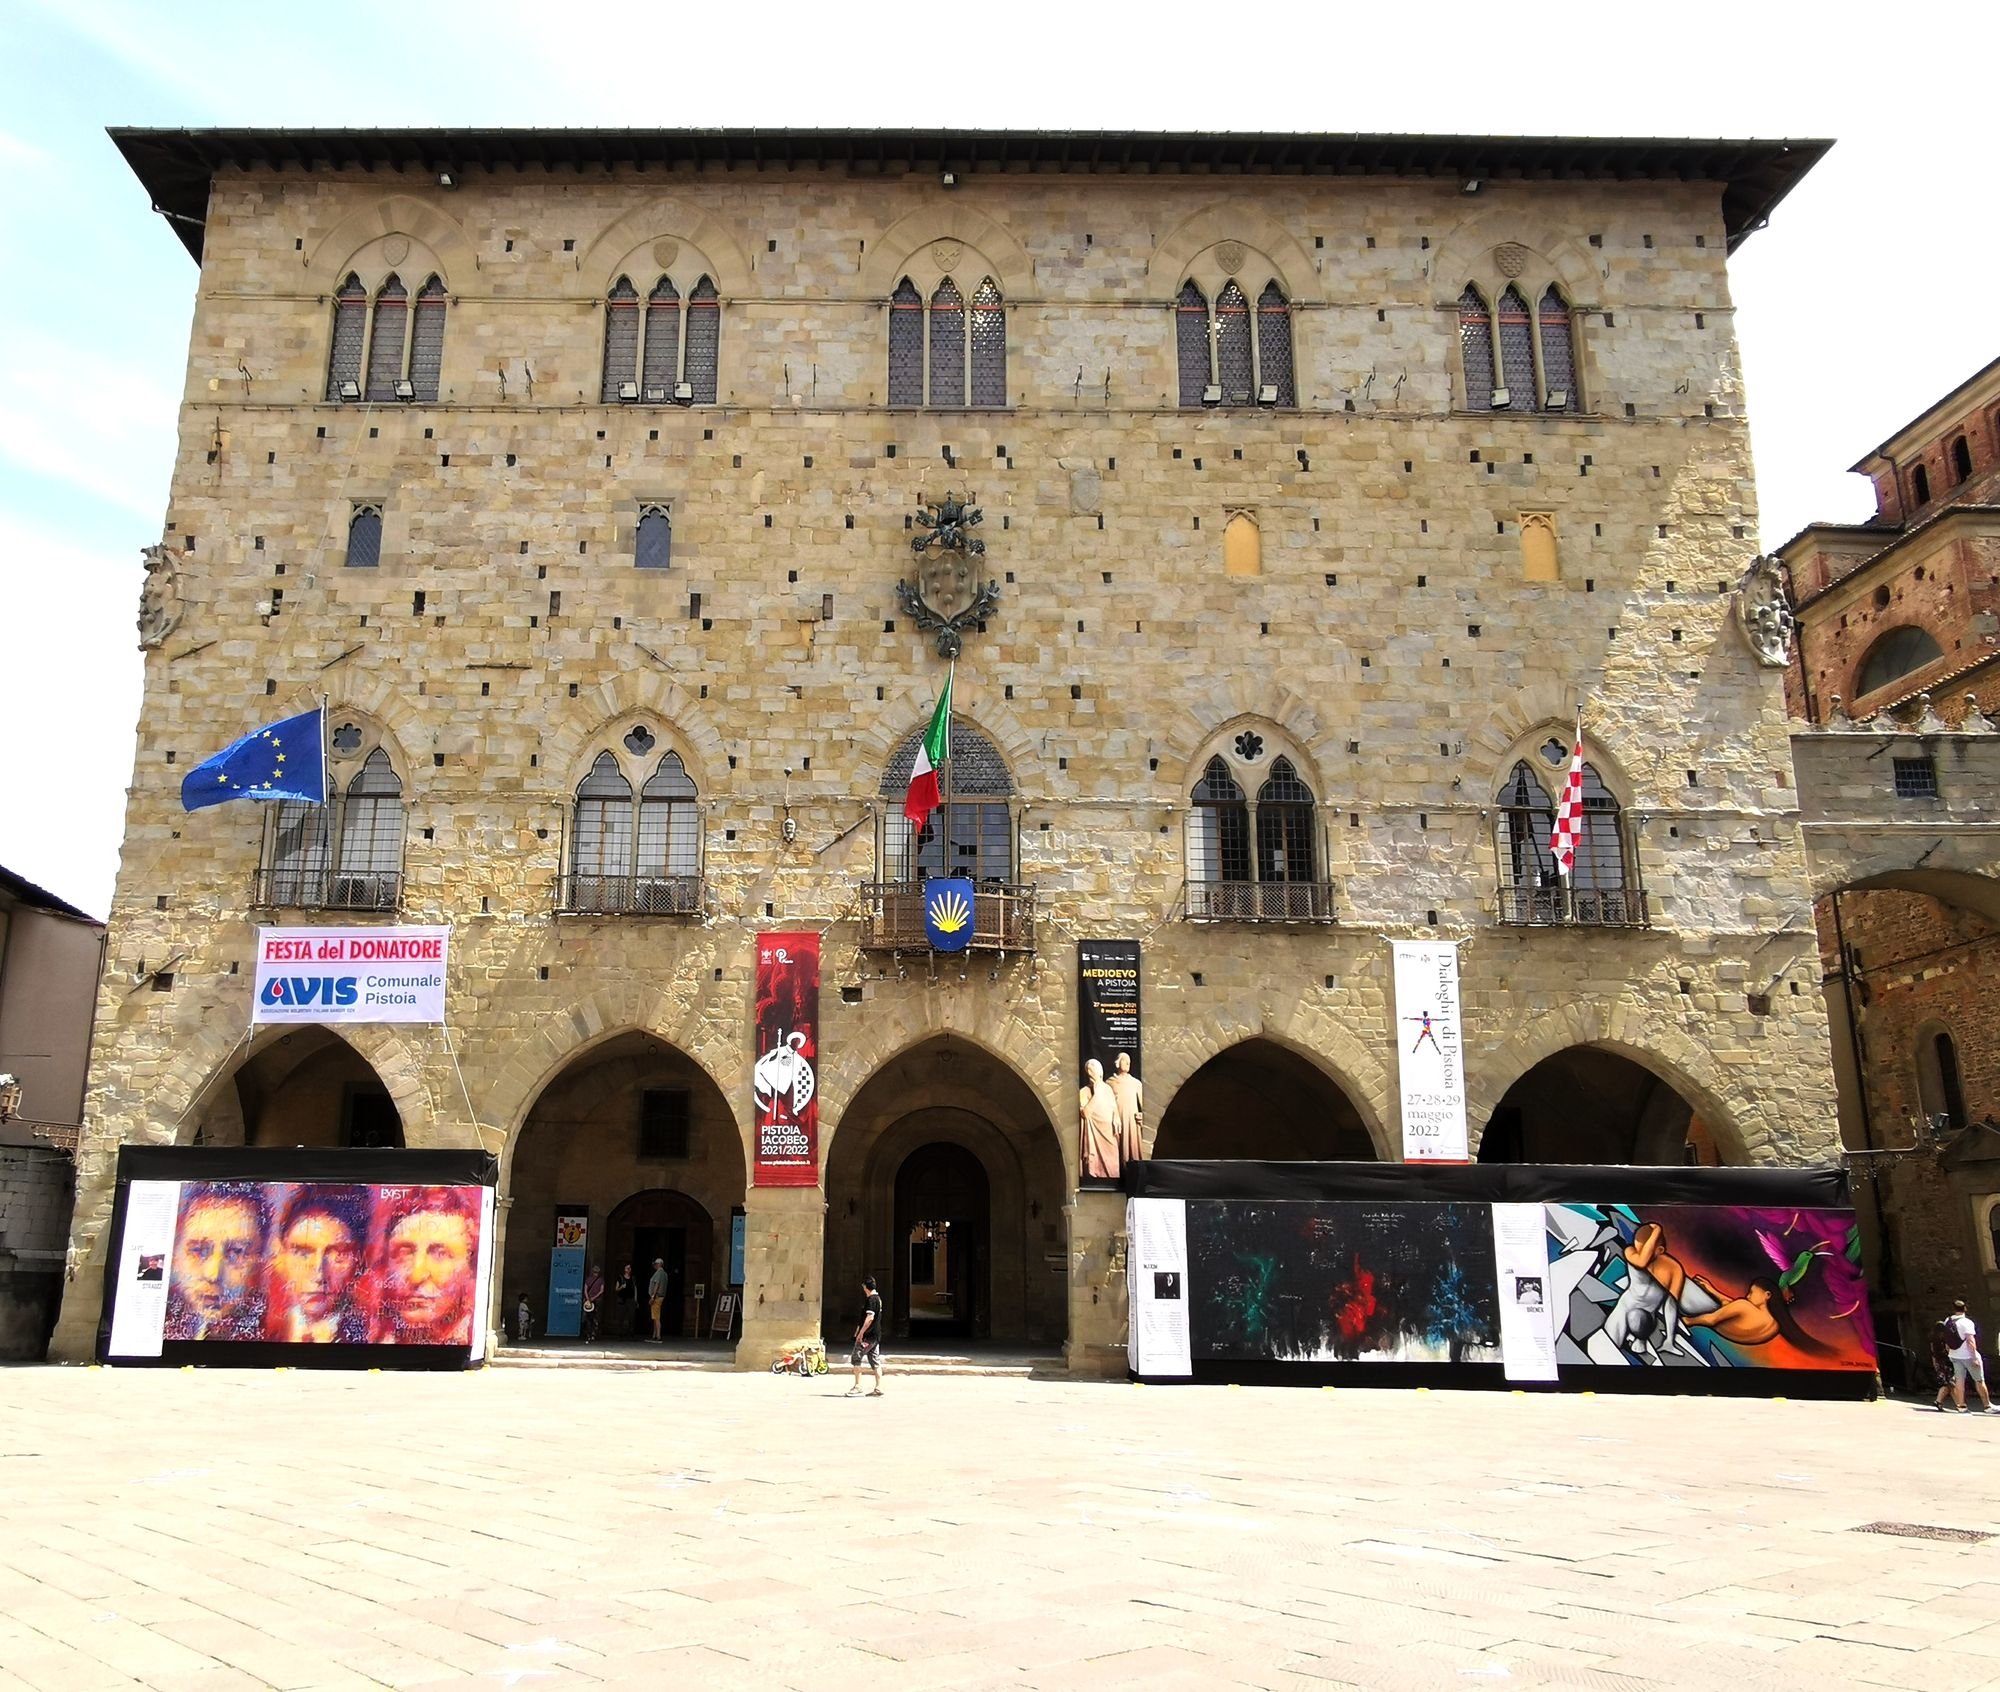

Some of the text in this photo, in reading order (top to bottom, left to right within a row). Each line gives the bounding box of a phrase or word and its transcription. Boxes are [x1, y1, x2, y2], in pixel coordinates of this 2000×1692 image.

[265, 939, 442, 960] FESTA del DONATORE
[1083, 968, 1137, 978] MEDIOEVO
[366, 975, 442, 988] Comunale
[1097, 979, 1137, 987] A PISTOIA
[260, 976, 359, 1006] AVIS
[365, 992, 417, 1005] Pistoia
[1435, 955, 1457, 1089] Dialoghi di Pistoia
[1408, 1108, 1453, 1123] maggio
[761, 1125, 801, 1135] PISTOIA
[1408, 1125, 1440, 1137] 2022
[761, 1135, 809, 1145] IACOBEO
[761, 1145, 809, 1155] 2021/2022
